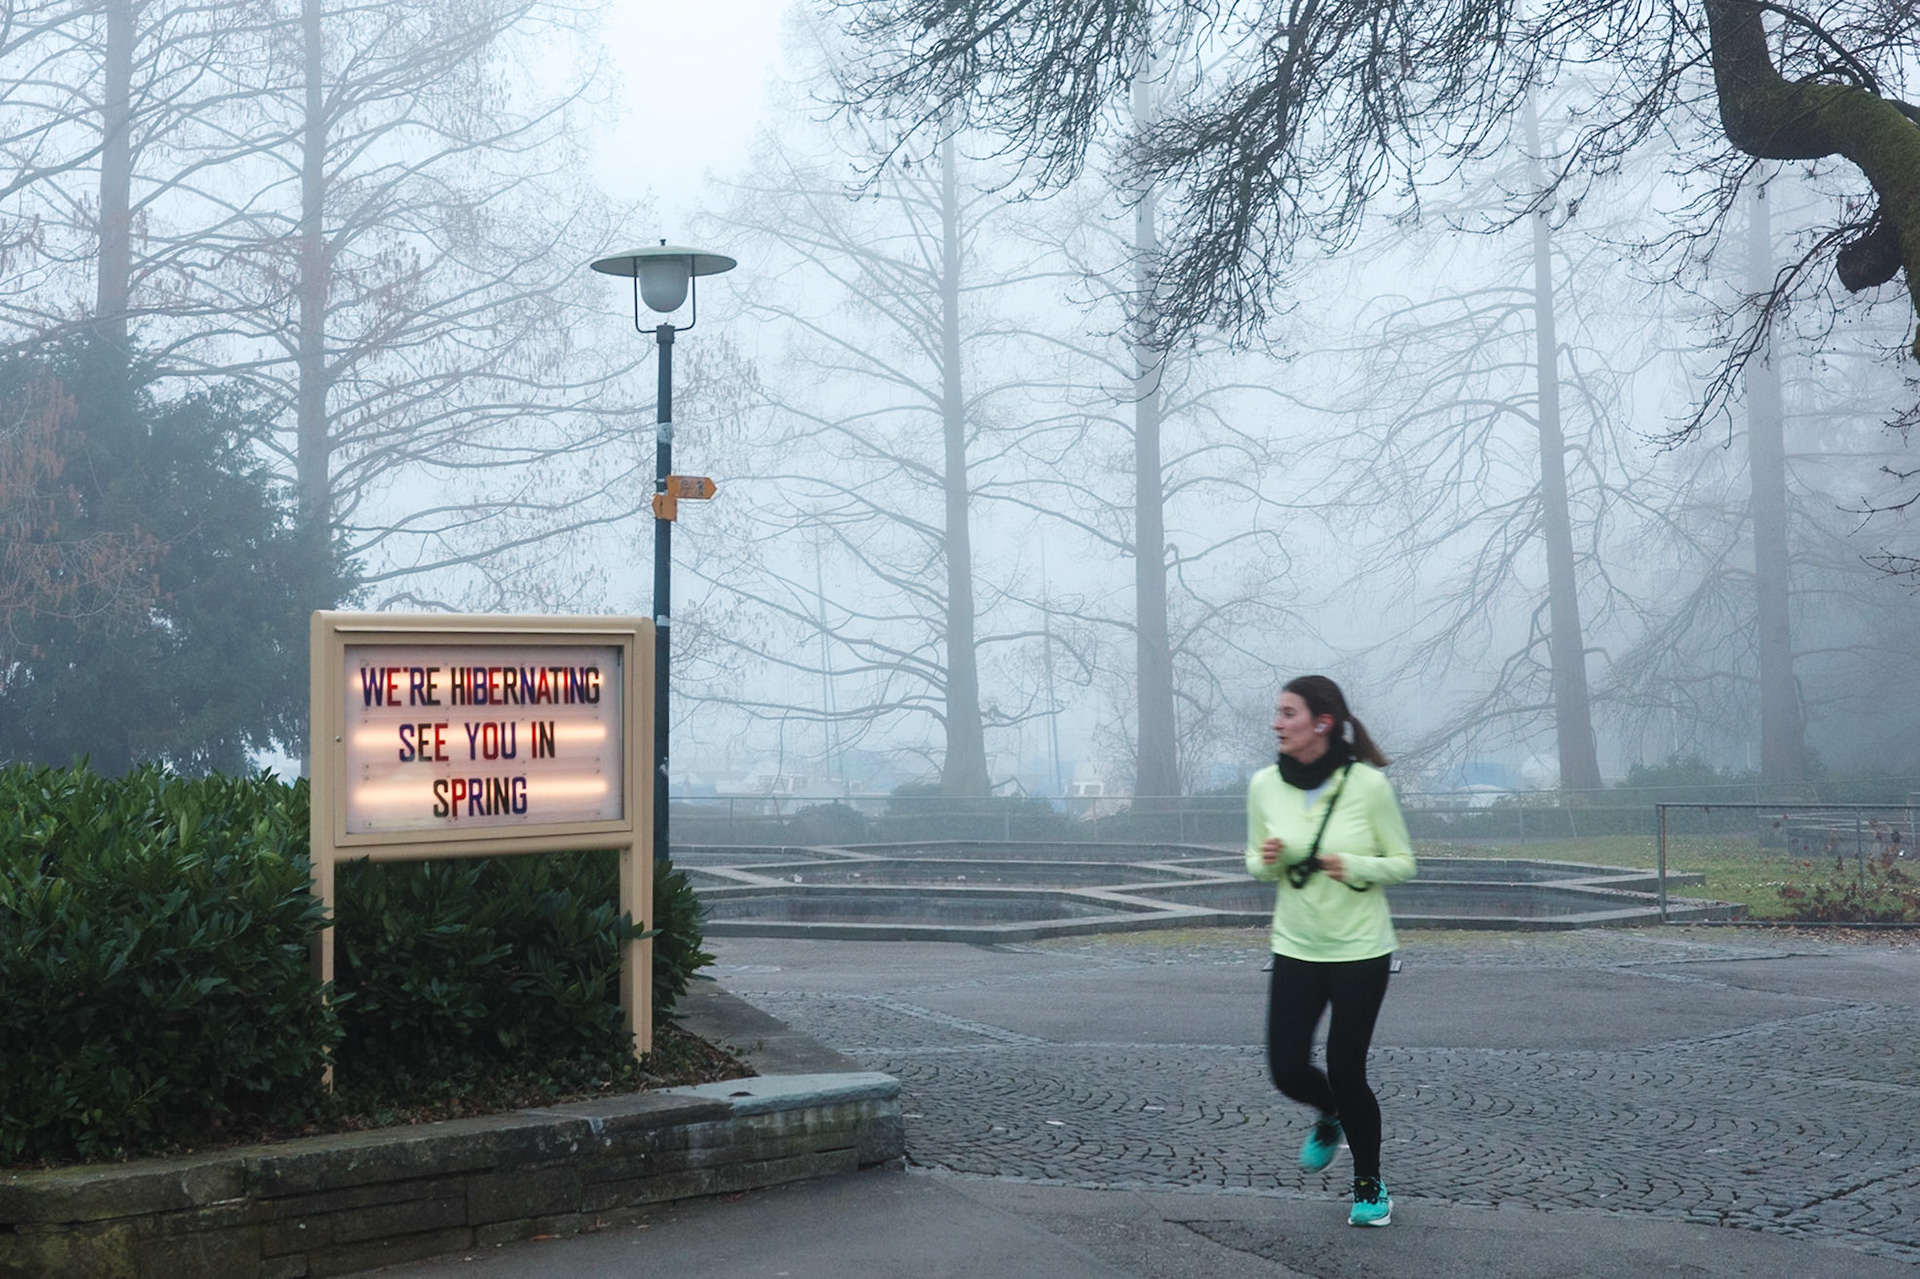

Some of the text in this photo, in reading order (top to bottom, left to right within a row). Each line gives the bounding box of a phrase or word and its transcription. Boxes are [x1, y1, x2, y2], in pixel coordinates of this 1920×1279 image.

[360, 667, 600, 706] WE'RE HIBERNATING
[399, 721, 555, 762] SEE YOU IN
[433, 776, 527, 817] SPRING
